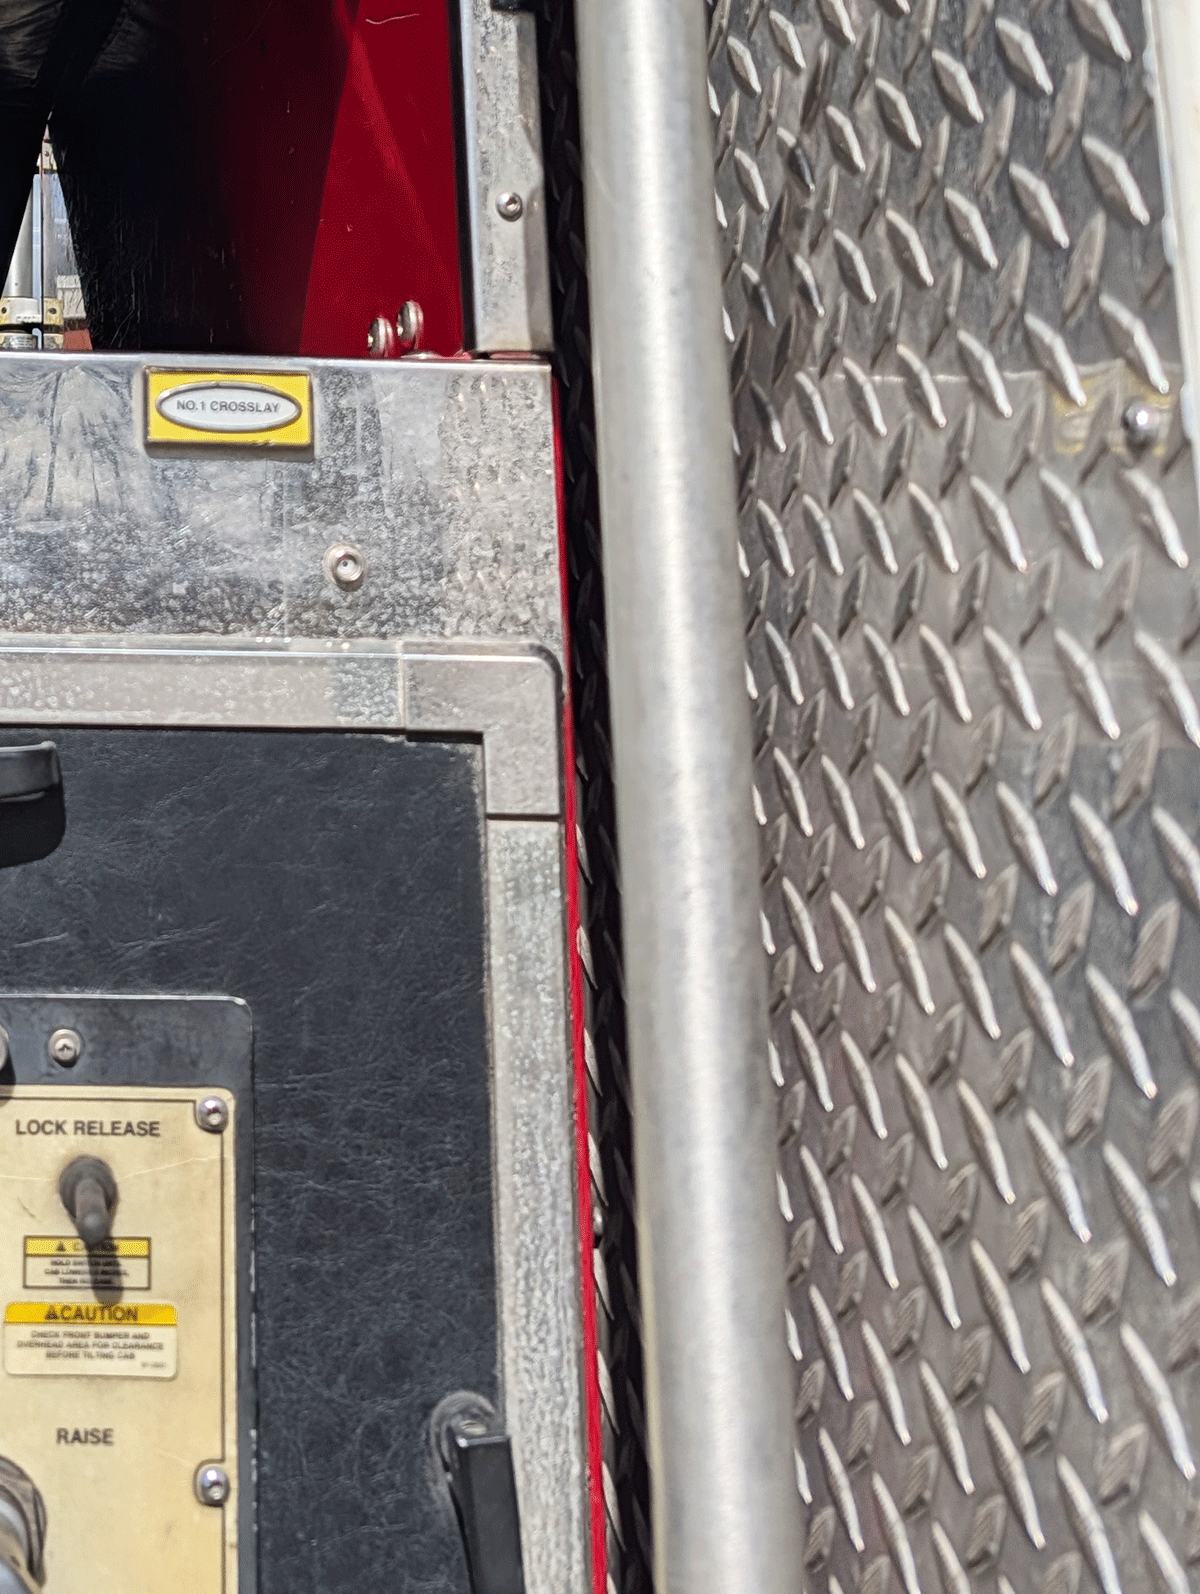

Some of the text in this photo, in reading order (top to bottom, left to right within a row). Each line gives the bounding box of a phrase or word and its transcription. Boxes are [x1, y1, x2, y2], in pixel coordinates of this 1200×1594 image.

[176, 399, 280, 413] NO.1 CROSSLAY
[15, 1120, 161, 1137] LOCK RELEASE
[60, 1305, 139, 1322] CAUTION
[56, 1427, 115, 1445] RAISE
